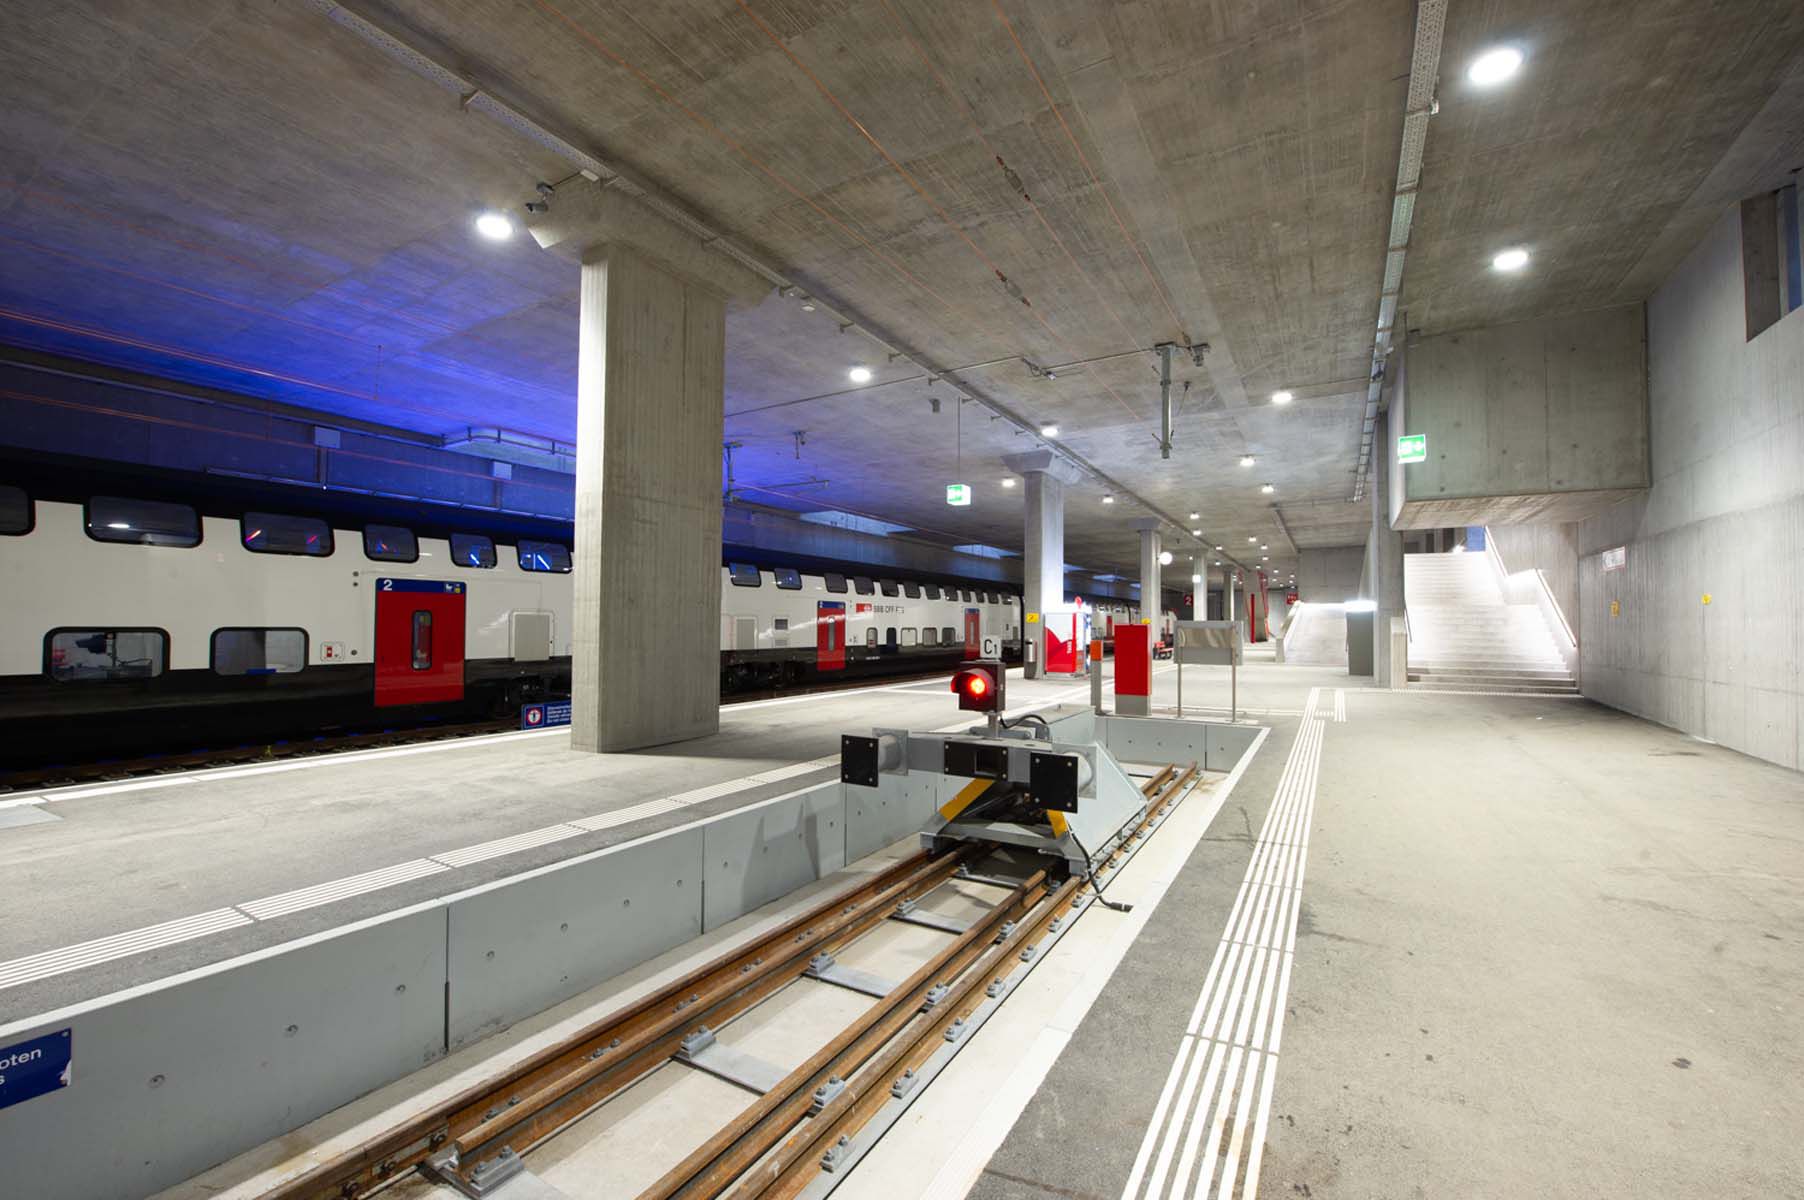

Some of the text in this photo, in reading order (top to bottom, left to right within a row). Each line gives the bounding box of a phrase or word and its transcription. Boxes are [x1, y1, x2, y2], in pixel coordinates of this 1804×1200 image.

[383, 579, 393, 591] 2
[1185, 596, 1192, 606] 2
[984, 639, 998, 655] C1
[0, 1048, 42, 1070] oten
